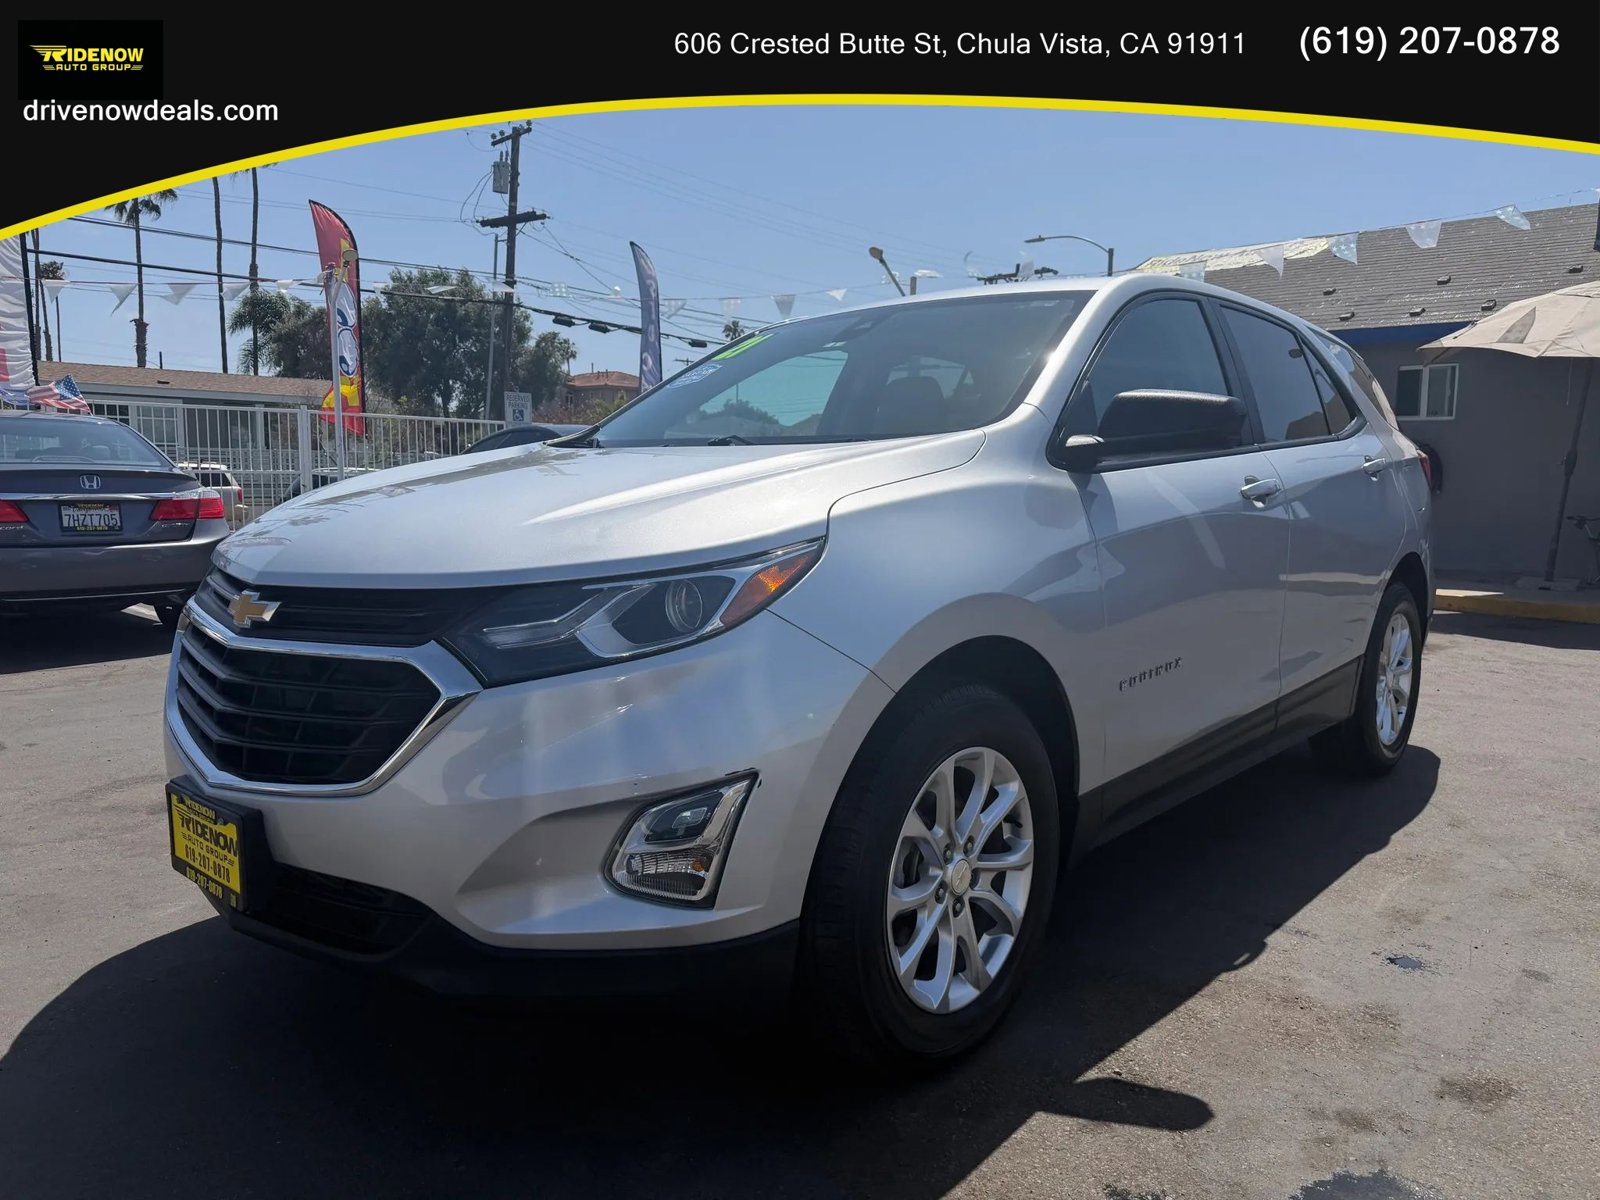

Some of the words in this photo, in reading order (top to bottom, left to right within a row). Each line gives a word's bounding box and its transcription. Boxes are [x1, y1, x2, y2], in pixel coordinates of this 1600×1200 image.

[63, 513, 118, 528] 7HZT705
[1119, 656, 1182, 692] EQUINOX
[175, 806, 238, 858] RIDENOW
[187, 833, 205, 851] AUTO
[205, 844, 228, 863] GROUP
[184, 844, 231, 884] 619-207-0878
